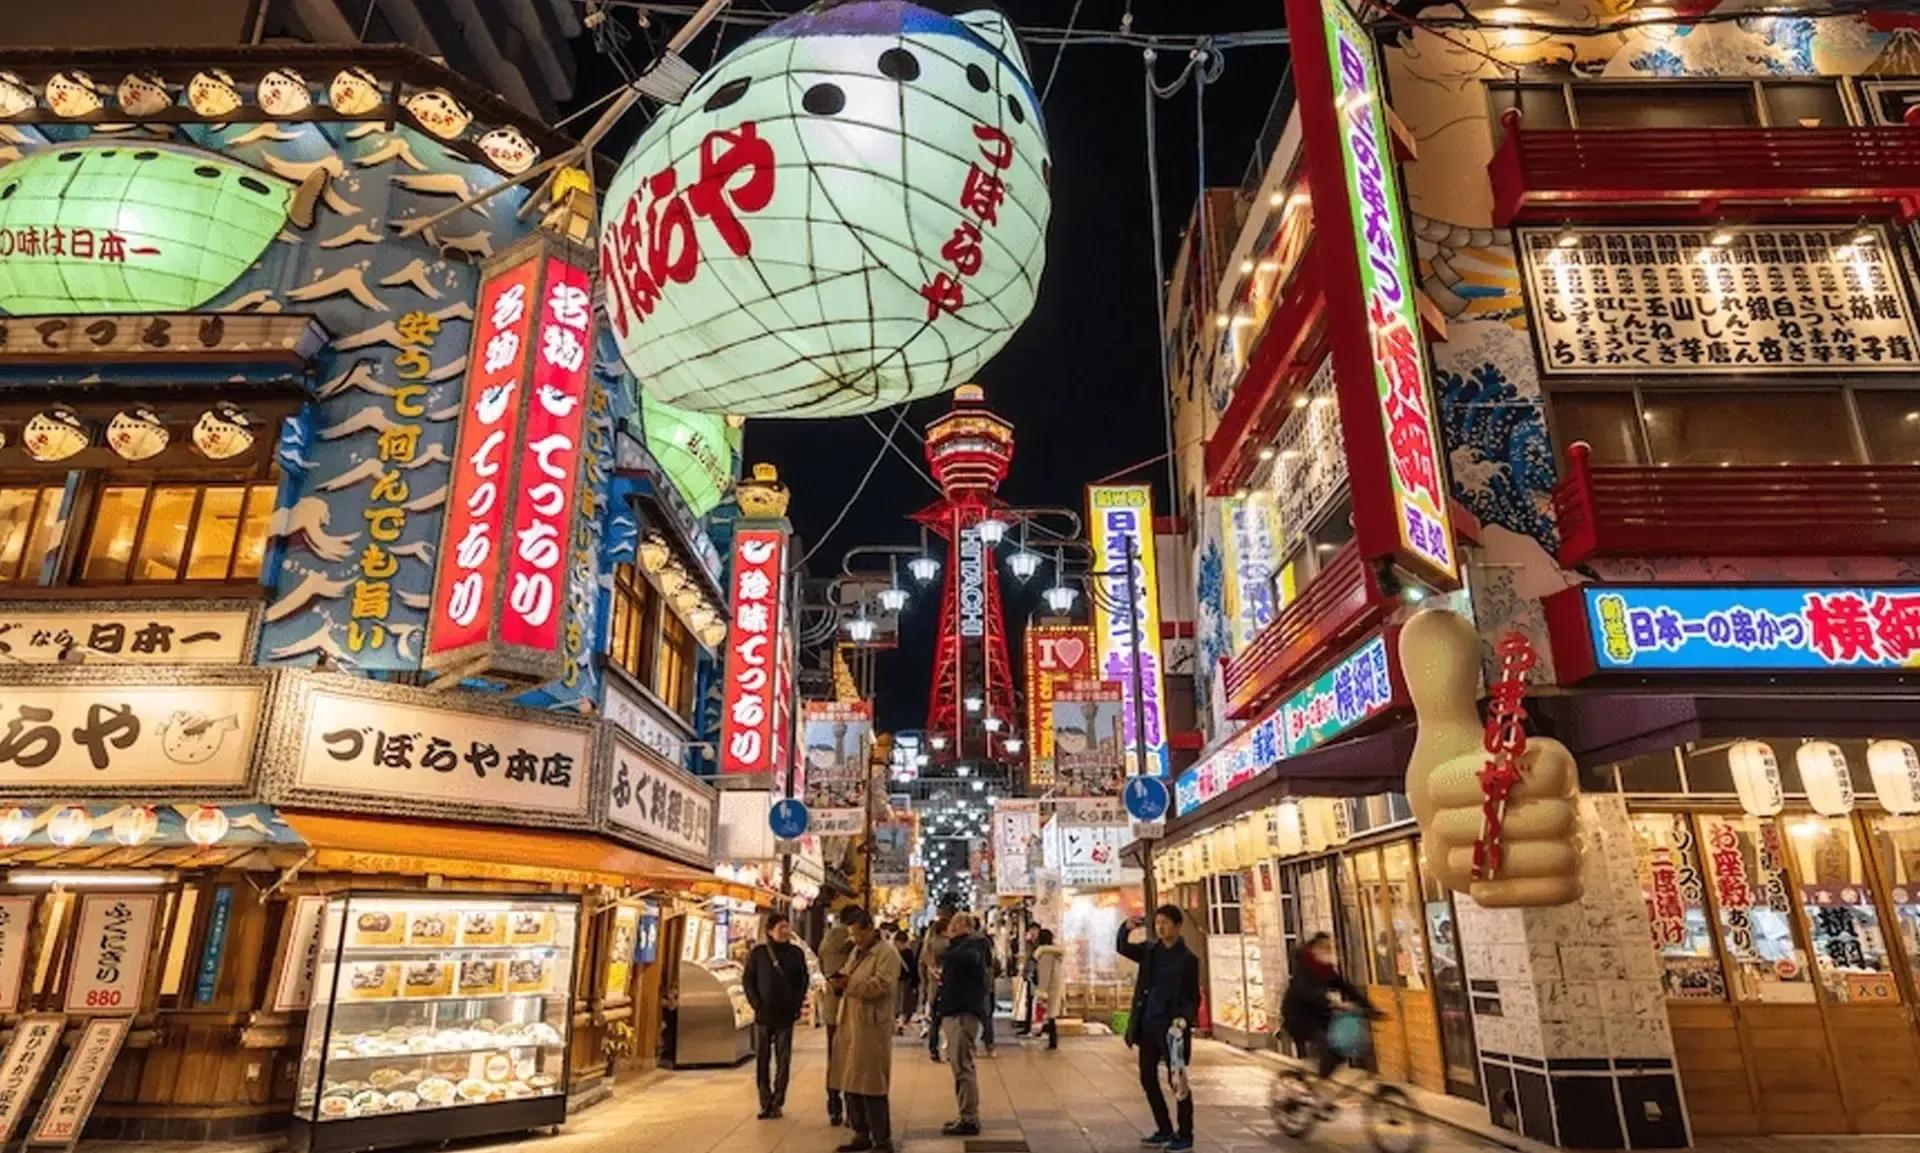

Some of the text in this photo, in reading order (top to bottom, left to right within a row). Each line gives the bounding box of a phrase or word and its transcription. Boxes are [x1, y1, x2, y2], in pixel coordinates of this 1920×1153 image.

[543, 281, 590, 373] 名物
[1544, 297, 1575, 364] もち
[1594, 297, 1630, 364] 紅しょうが
[1618, 297, 1651, 364] にんにく
[1645, 297, 1678, 364] 玉ねぎ
[1721, 296, 1759, 364] れんこん
[1746, 296, 1783, 363] 銀杏
[1772, 296, 1807, 363] 白ねぎ
[1369, 291, 1442, 513] 横綱
[961, 529, 983, 636] HITACHI
[1630, 610, 1804, 648] 日本一の串かつ
[1805, 595, 1920, 660] 横綱
[322, 727, 573, 788] づぼらや本店
[1651, 847, 1684, 944] 二度漬け
[1672, 831, 1701, 900] ソースの
[1711, 823, 1752, 951] お座敷あり
[86, 989, 121, 1006] 880
[1859, 984, 1888, 998] 入口
